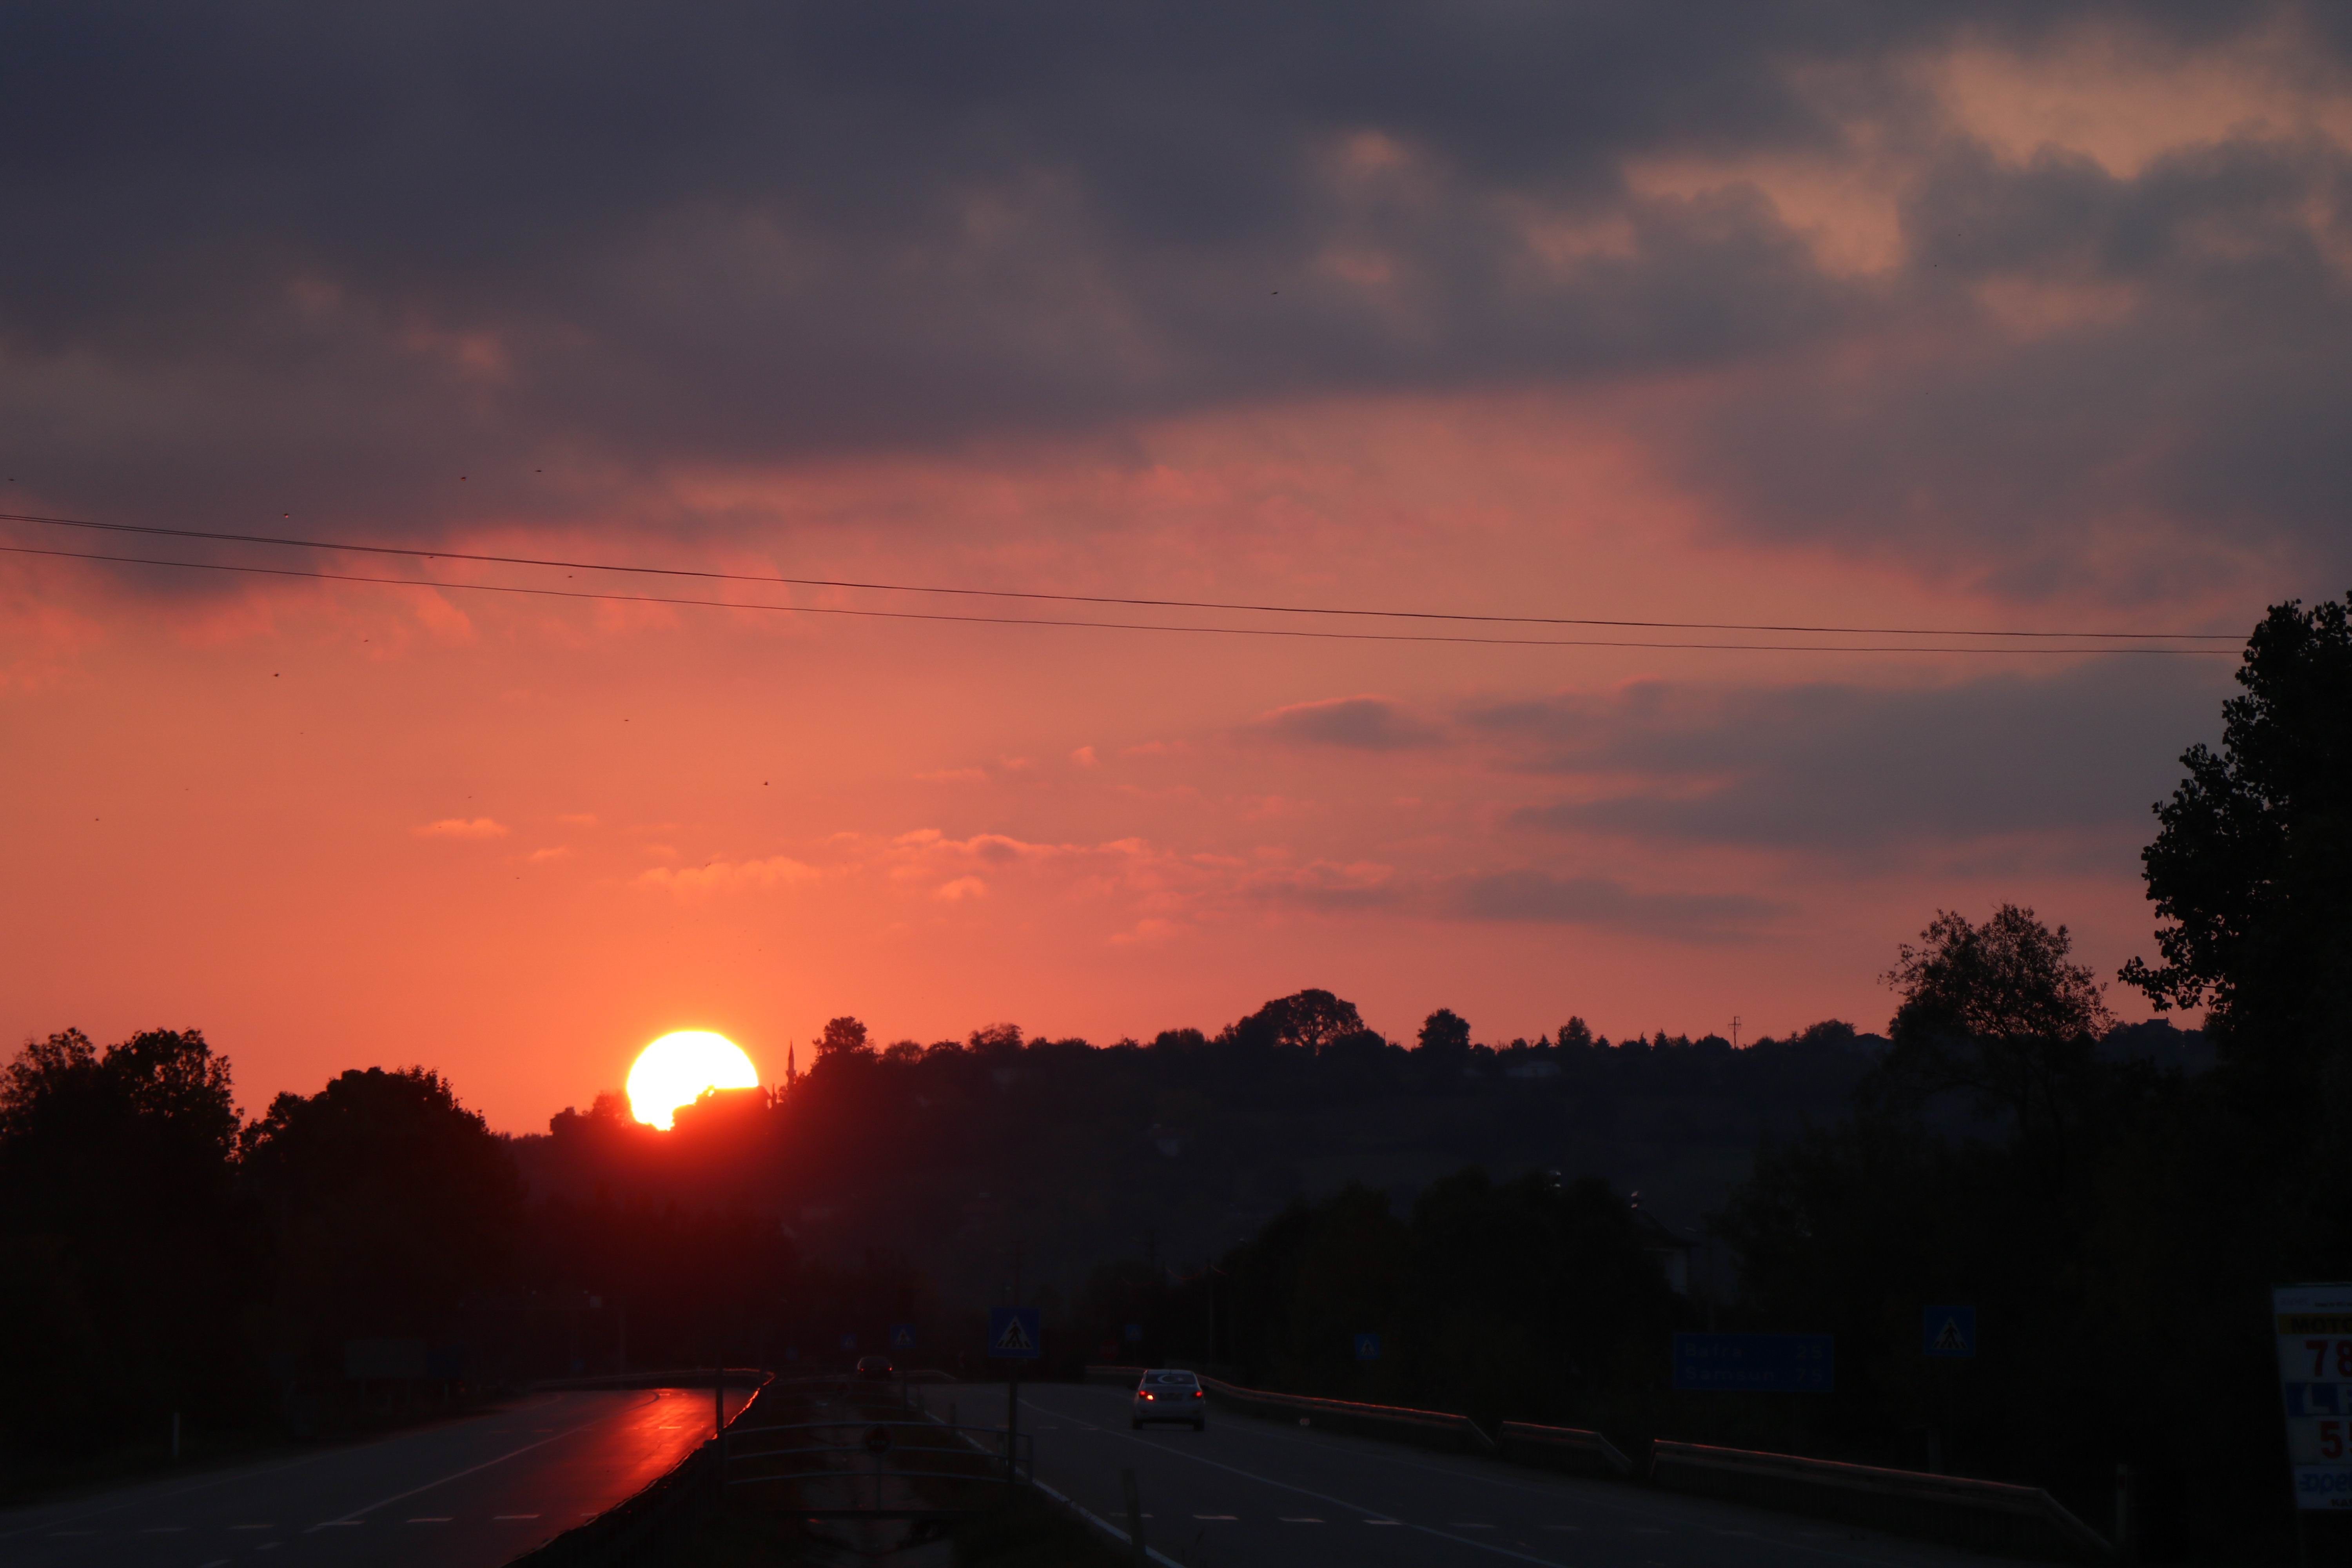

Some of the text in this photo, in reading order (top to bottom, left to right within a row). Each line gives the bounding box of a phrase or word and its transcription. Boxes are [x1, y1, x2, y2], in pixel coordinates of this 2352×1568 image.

[1685, 1343, 1822, 1359] Bafra 25
[1685, 1365, 1822, 1382] Samsun 75
[2321, 1421, 2352, 1459] 5
